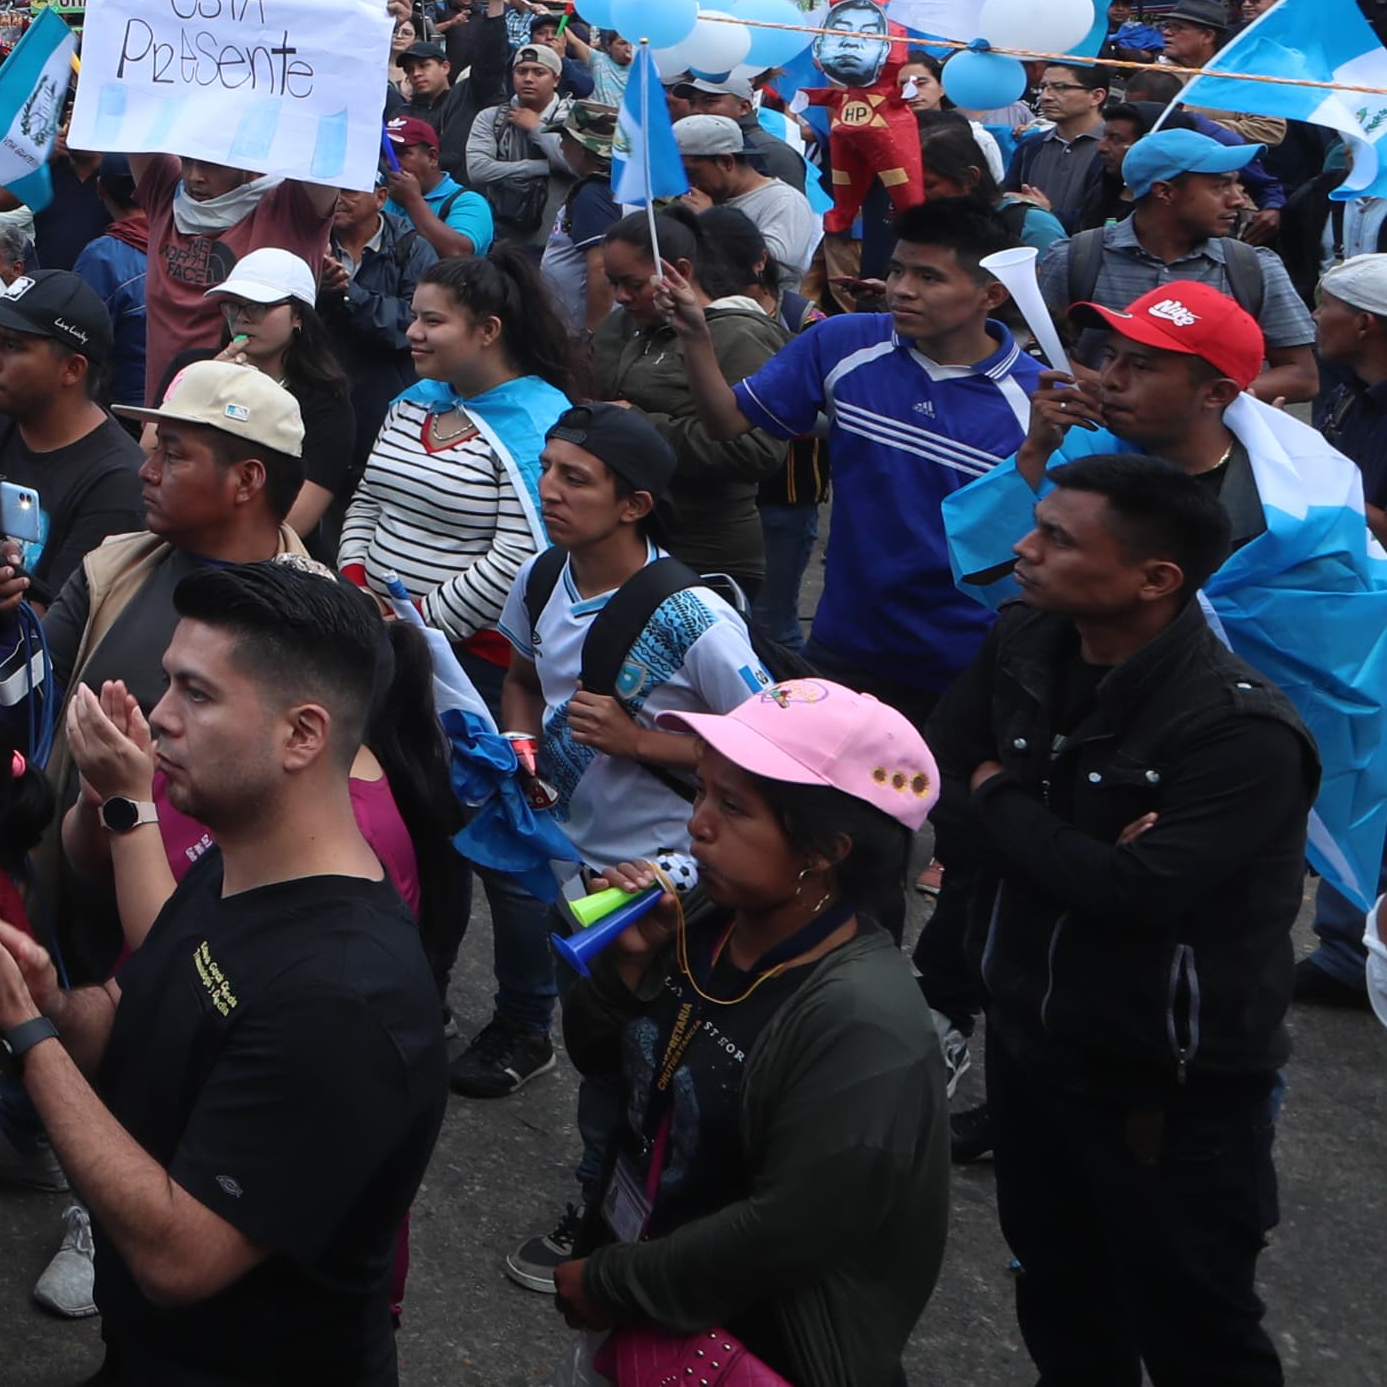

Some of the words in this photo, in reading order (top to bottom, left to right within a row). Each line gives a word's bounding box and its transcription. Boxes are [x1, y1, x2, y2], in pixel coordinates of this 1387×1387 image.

[844, 106, 868, 122] HP
[186, 239, 211, 252] THE
[167, 260, 207, 284] FACE
